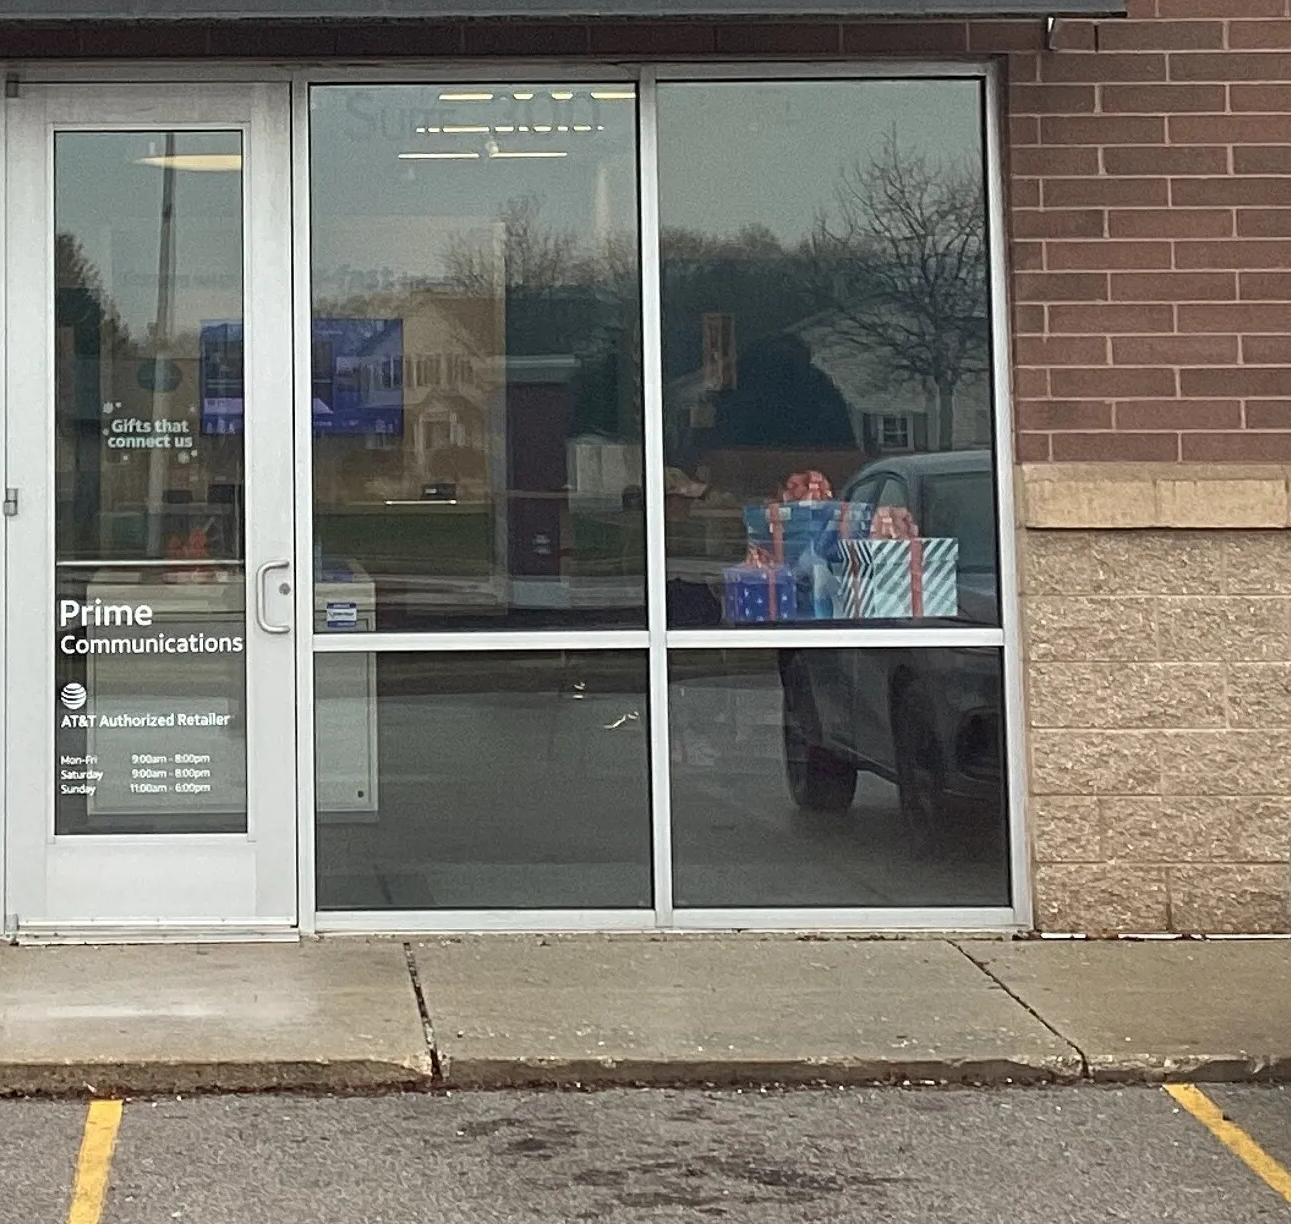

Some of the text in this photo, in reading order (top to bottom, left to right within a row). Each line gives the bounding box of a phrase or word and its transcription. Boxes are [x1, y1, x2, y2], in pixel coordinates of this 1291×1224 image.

[111, 418, 189, 433] Gifts that
[107, 434, 193, 449] connect us
[60, 598, 153, 627] Prime
[60, 633, 244, 655] Communications
[61, 712, 230, 728] AT&T Authorized Retailer
[61, 755, 98, 765] Mon-Fri
[131, 754, 167, 764] 9:00am
[174, 753, 210, 766] 8:00pm
[61, 770, 104, 781] Saturday
[131, 769, 167, 779] 9:00am
[174, 768, 210, 780] 8:00pm
[61, 784, 97, 796] Sunday
[130, 783, 167, 793] 11:00am
[174, 783, 211, 794] 6:00pm
